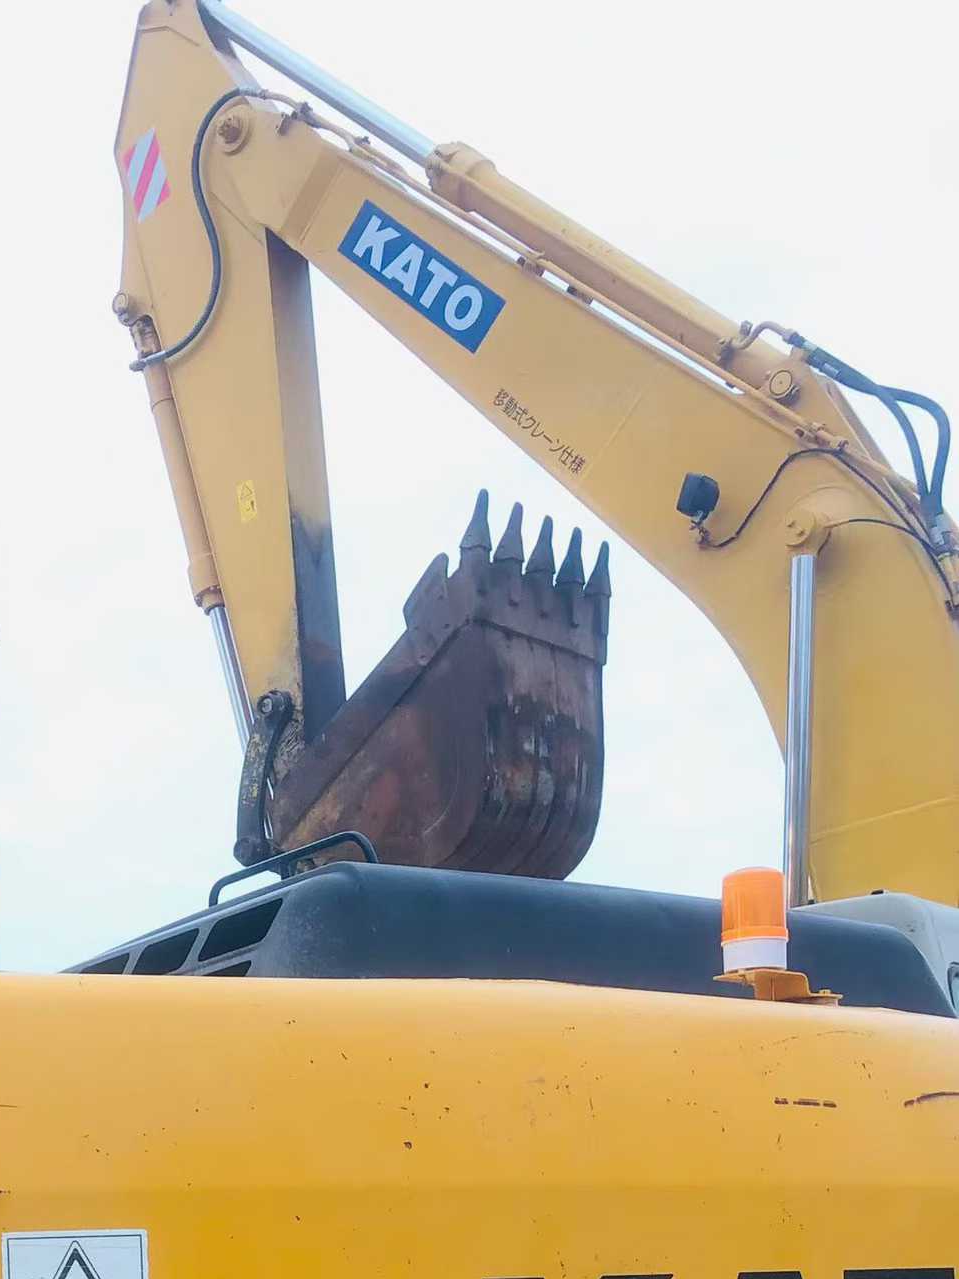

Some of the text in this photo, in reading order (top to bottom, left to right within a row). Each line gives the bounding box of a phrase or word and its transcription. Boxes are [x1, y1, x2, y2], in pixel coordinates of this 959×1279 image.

[352, 214, 484, 332] KATO
[493, 388, 586, 474] 移動式クレーン仕様
